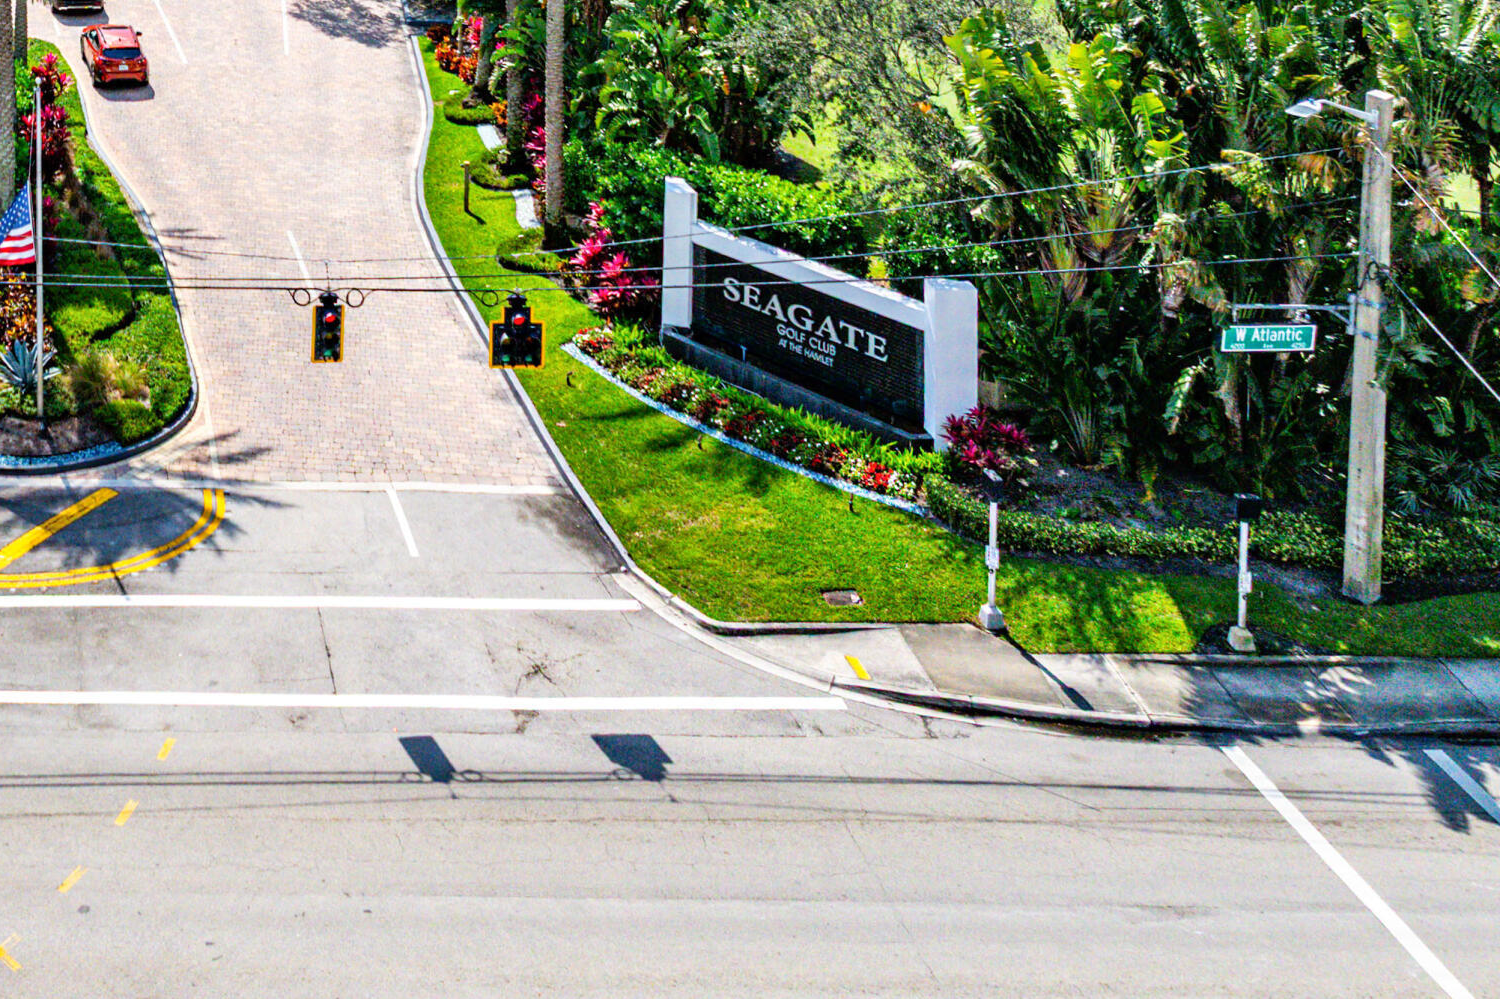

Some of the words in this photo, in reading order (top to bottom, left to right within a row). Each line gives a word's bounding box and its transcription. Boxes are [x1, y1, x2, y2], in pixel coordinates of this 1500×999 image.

[723, 277, 888, 362] SEAGATE
[1235, 327, 1247, 342] W
[1251, 326, 1304, 342] Atlantic
[776, 323, 806, 343] GOLF
[808, 337, 837, 357] CLUB
[778, 338, 788, 349] AT
[789, 342, 802, 355] THE
[804, 348, 834, 368] HAMLET
